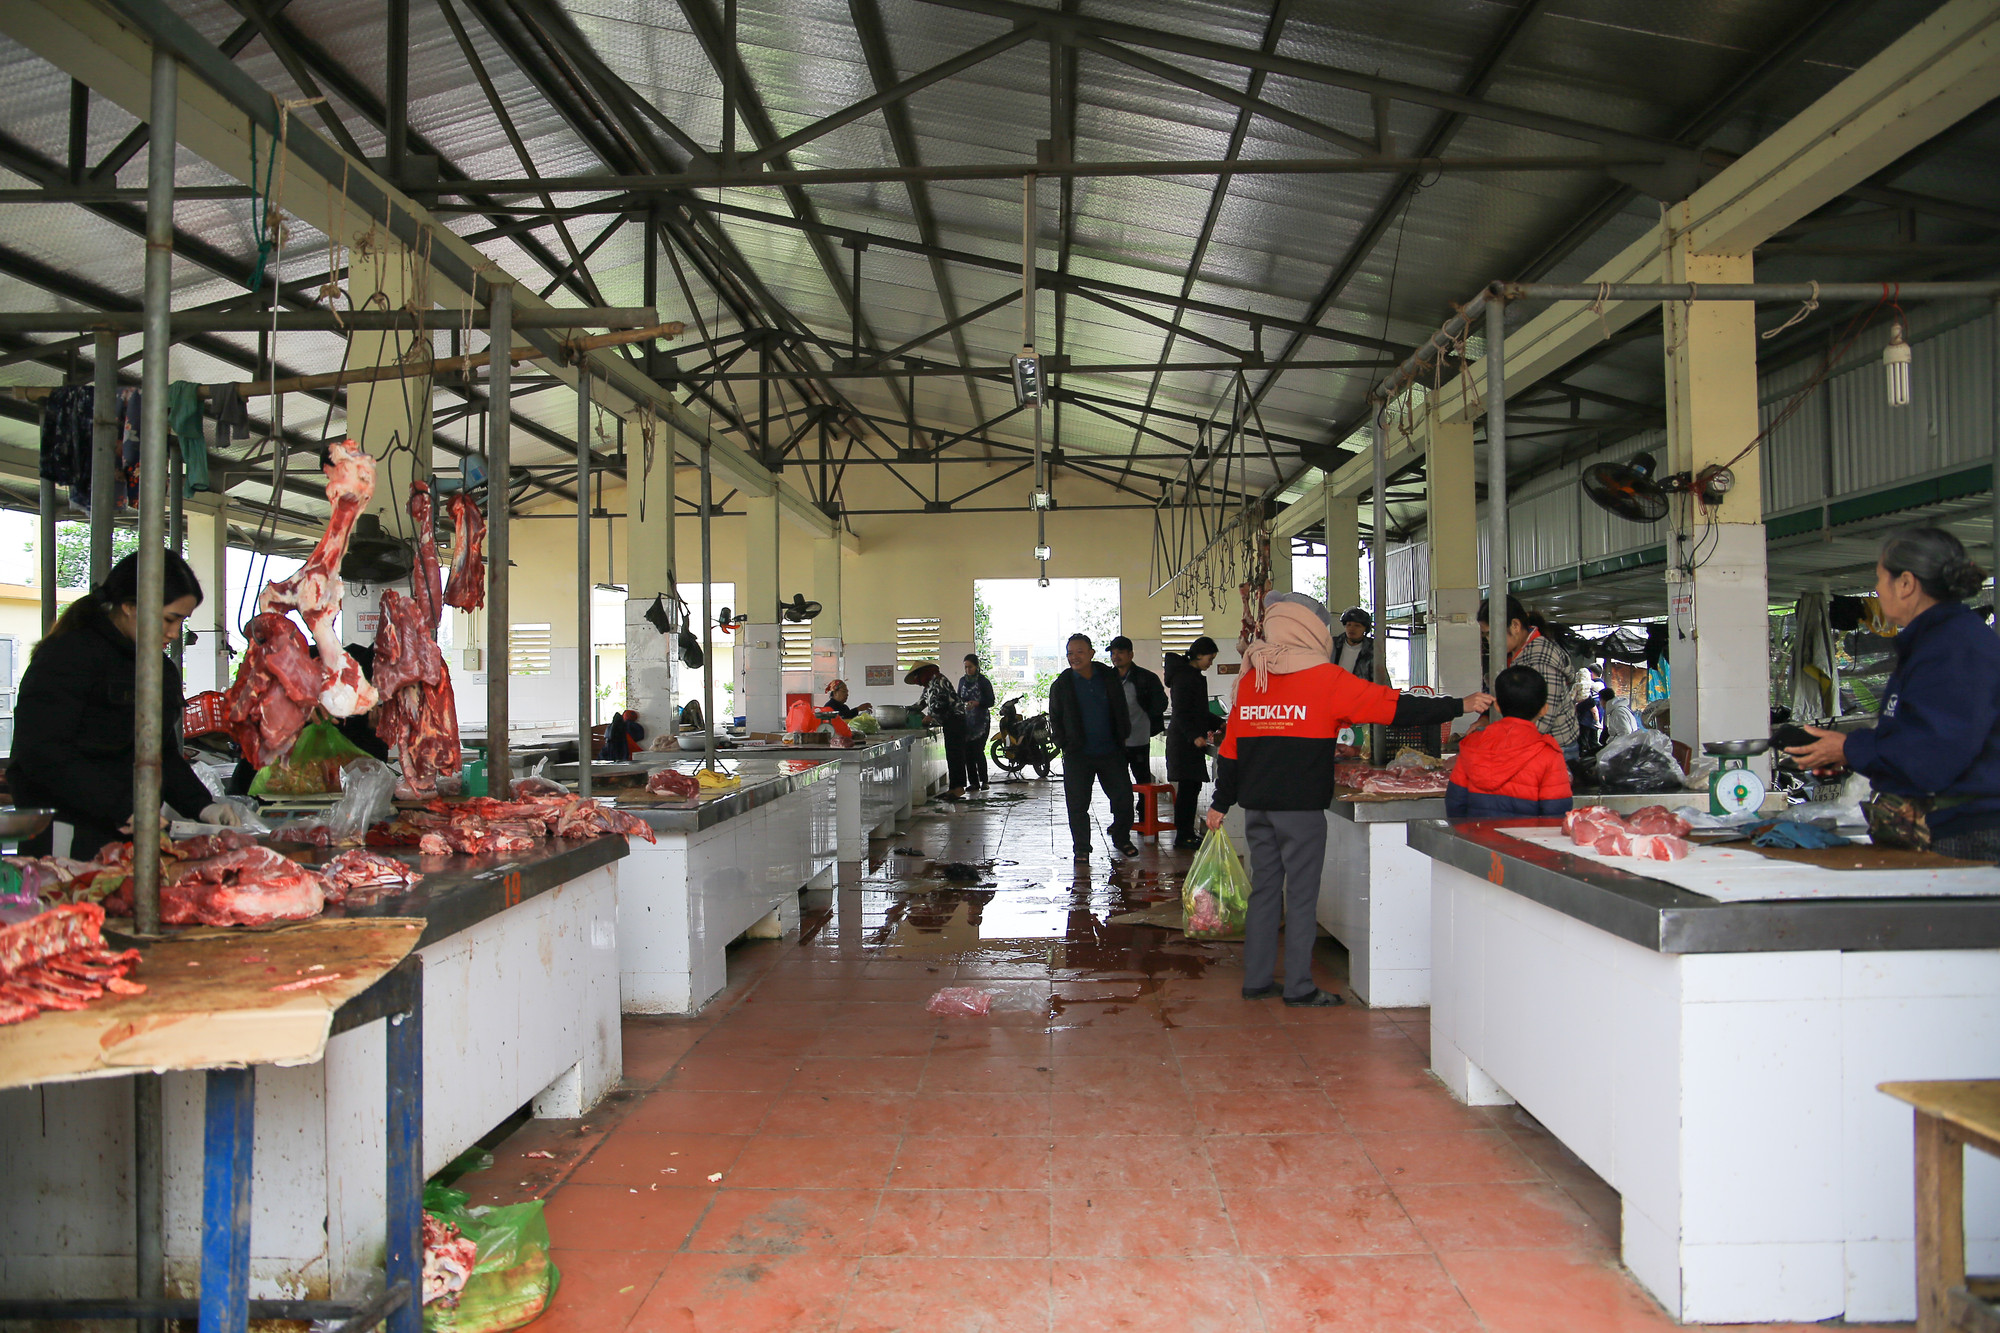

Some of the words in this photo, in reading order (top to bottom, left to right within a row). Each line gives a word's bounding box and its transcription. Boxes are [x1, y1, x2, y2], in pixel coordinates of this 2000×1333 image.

[1240, 705, 1306, 720] BROKLYN
[1488, 851, 1505, 886] 36
[503, 871, 521, 909] 19
